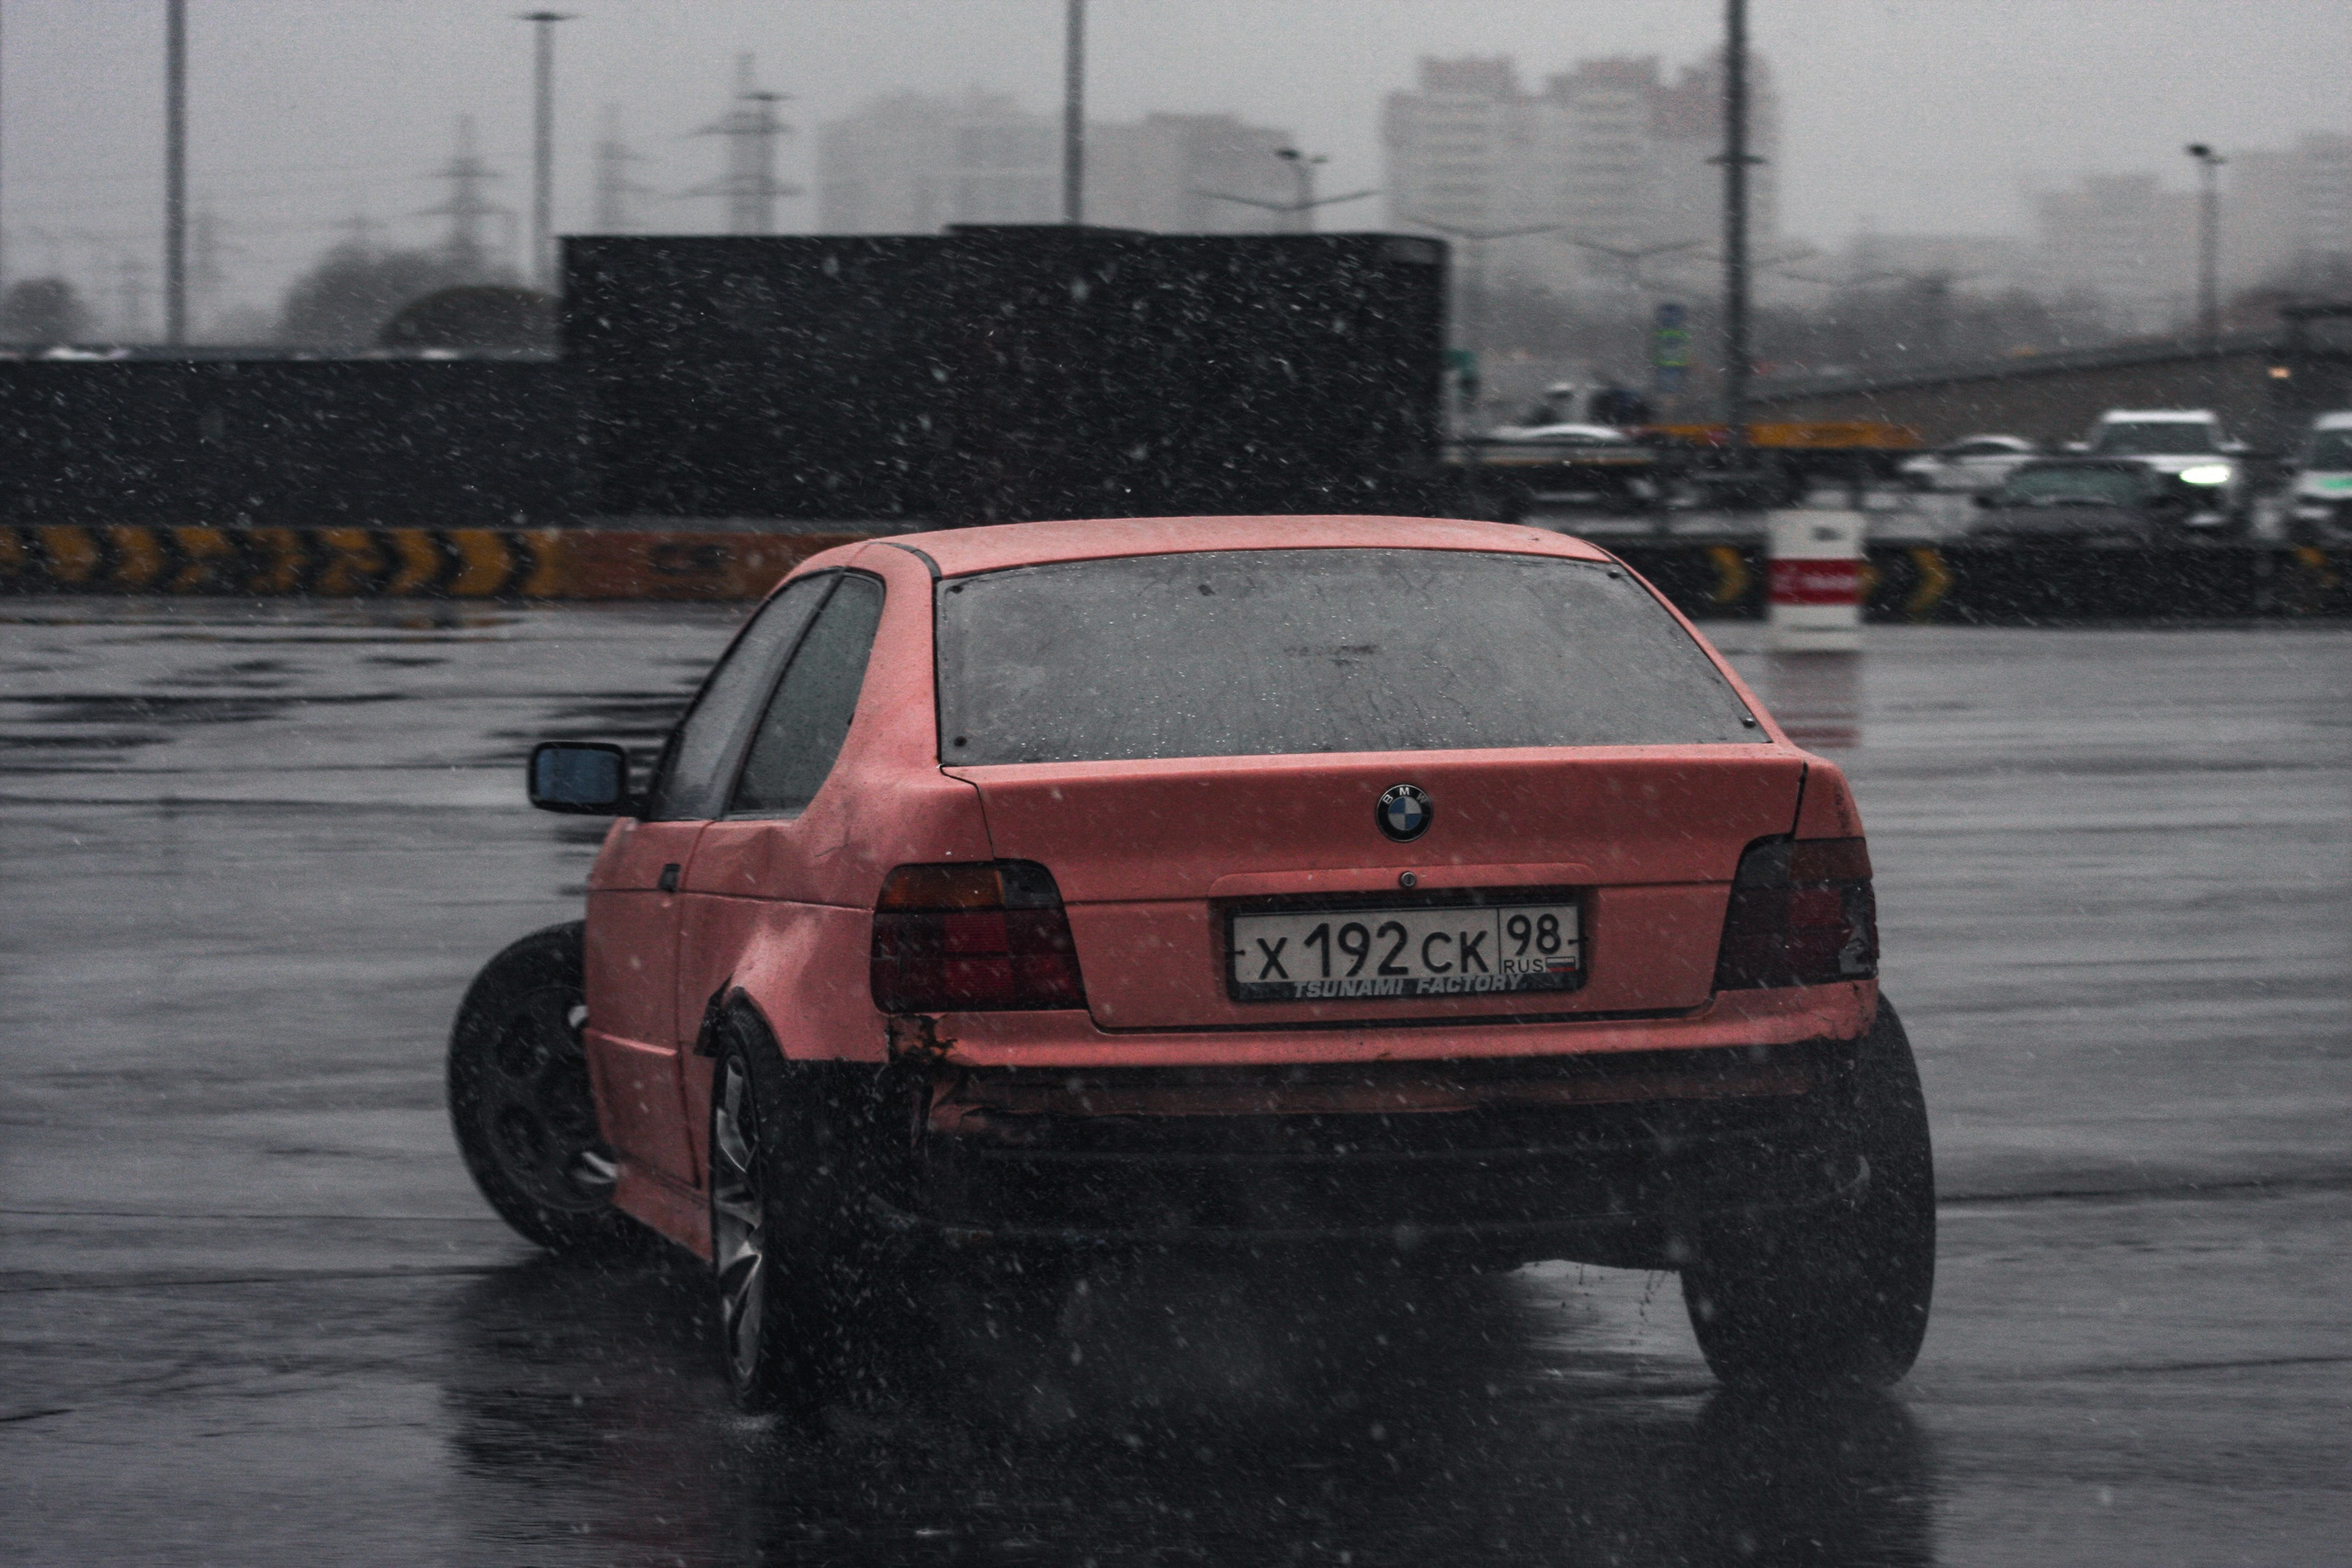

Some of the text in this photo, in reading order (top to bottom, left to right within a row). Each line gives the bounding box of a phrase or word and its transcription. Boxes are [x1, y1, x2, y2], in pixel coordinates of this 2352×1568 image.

[1382, 786, 1428, 806] BMW
[1507, 914, 1561, 956] 98
[1503, 959, 1544, 974] RUS
[1294, 974, 1522, 998] TSUNAMI FACTORY
